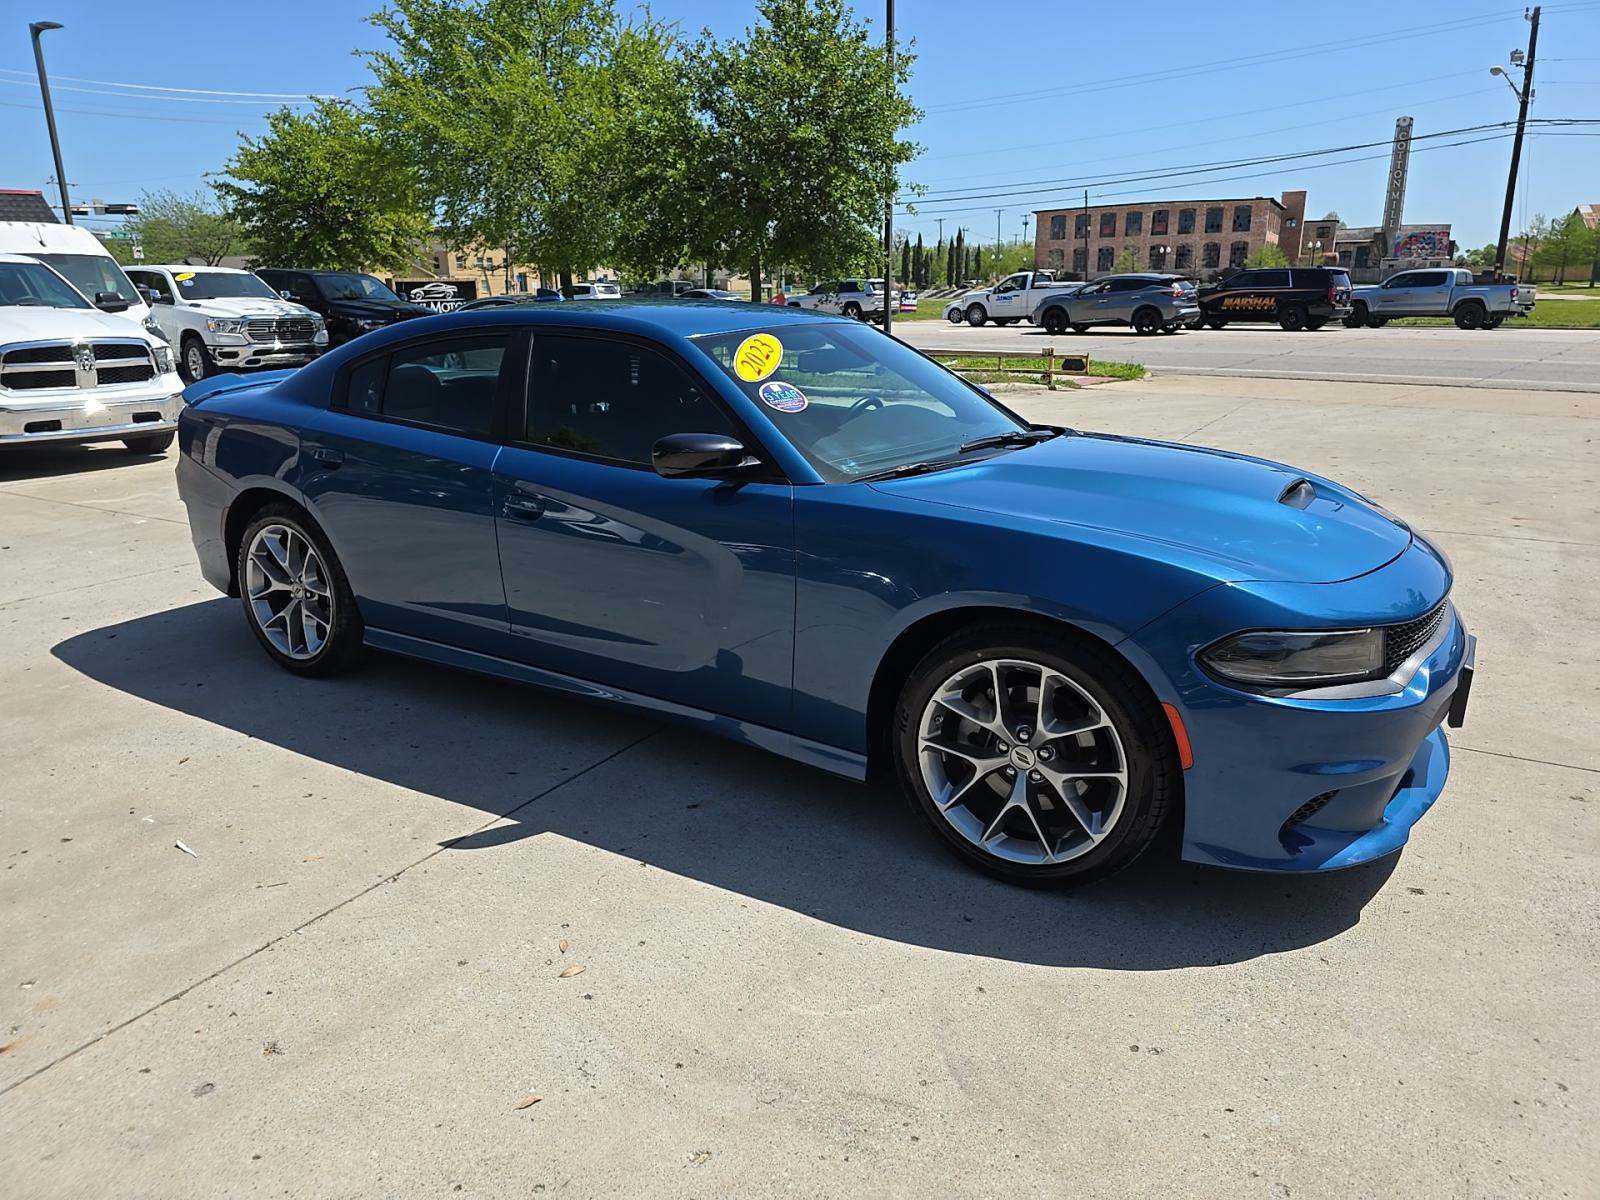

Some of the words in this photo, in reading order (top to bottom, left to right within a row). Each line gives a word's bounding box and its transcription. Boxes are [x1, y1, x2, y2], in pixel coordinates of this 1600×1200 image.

[1393, 132, 1407, 187] COTTON
[1389, 192, 1400, 228] MILL
[1223, 296, 1276, 305] MARSHAL
[741, 338, 774, 376] 2023
